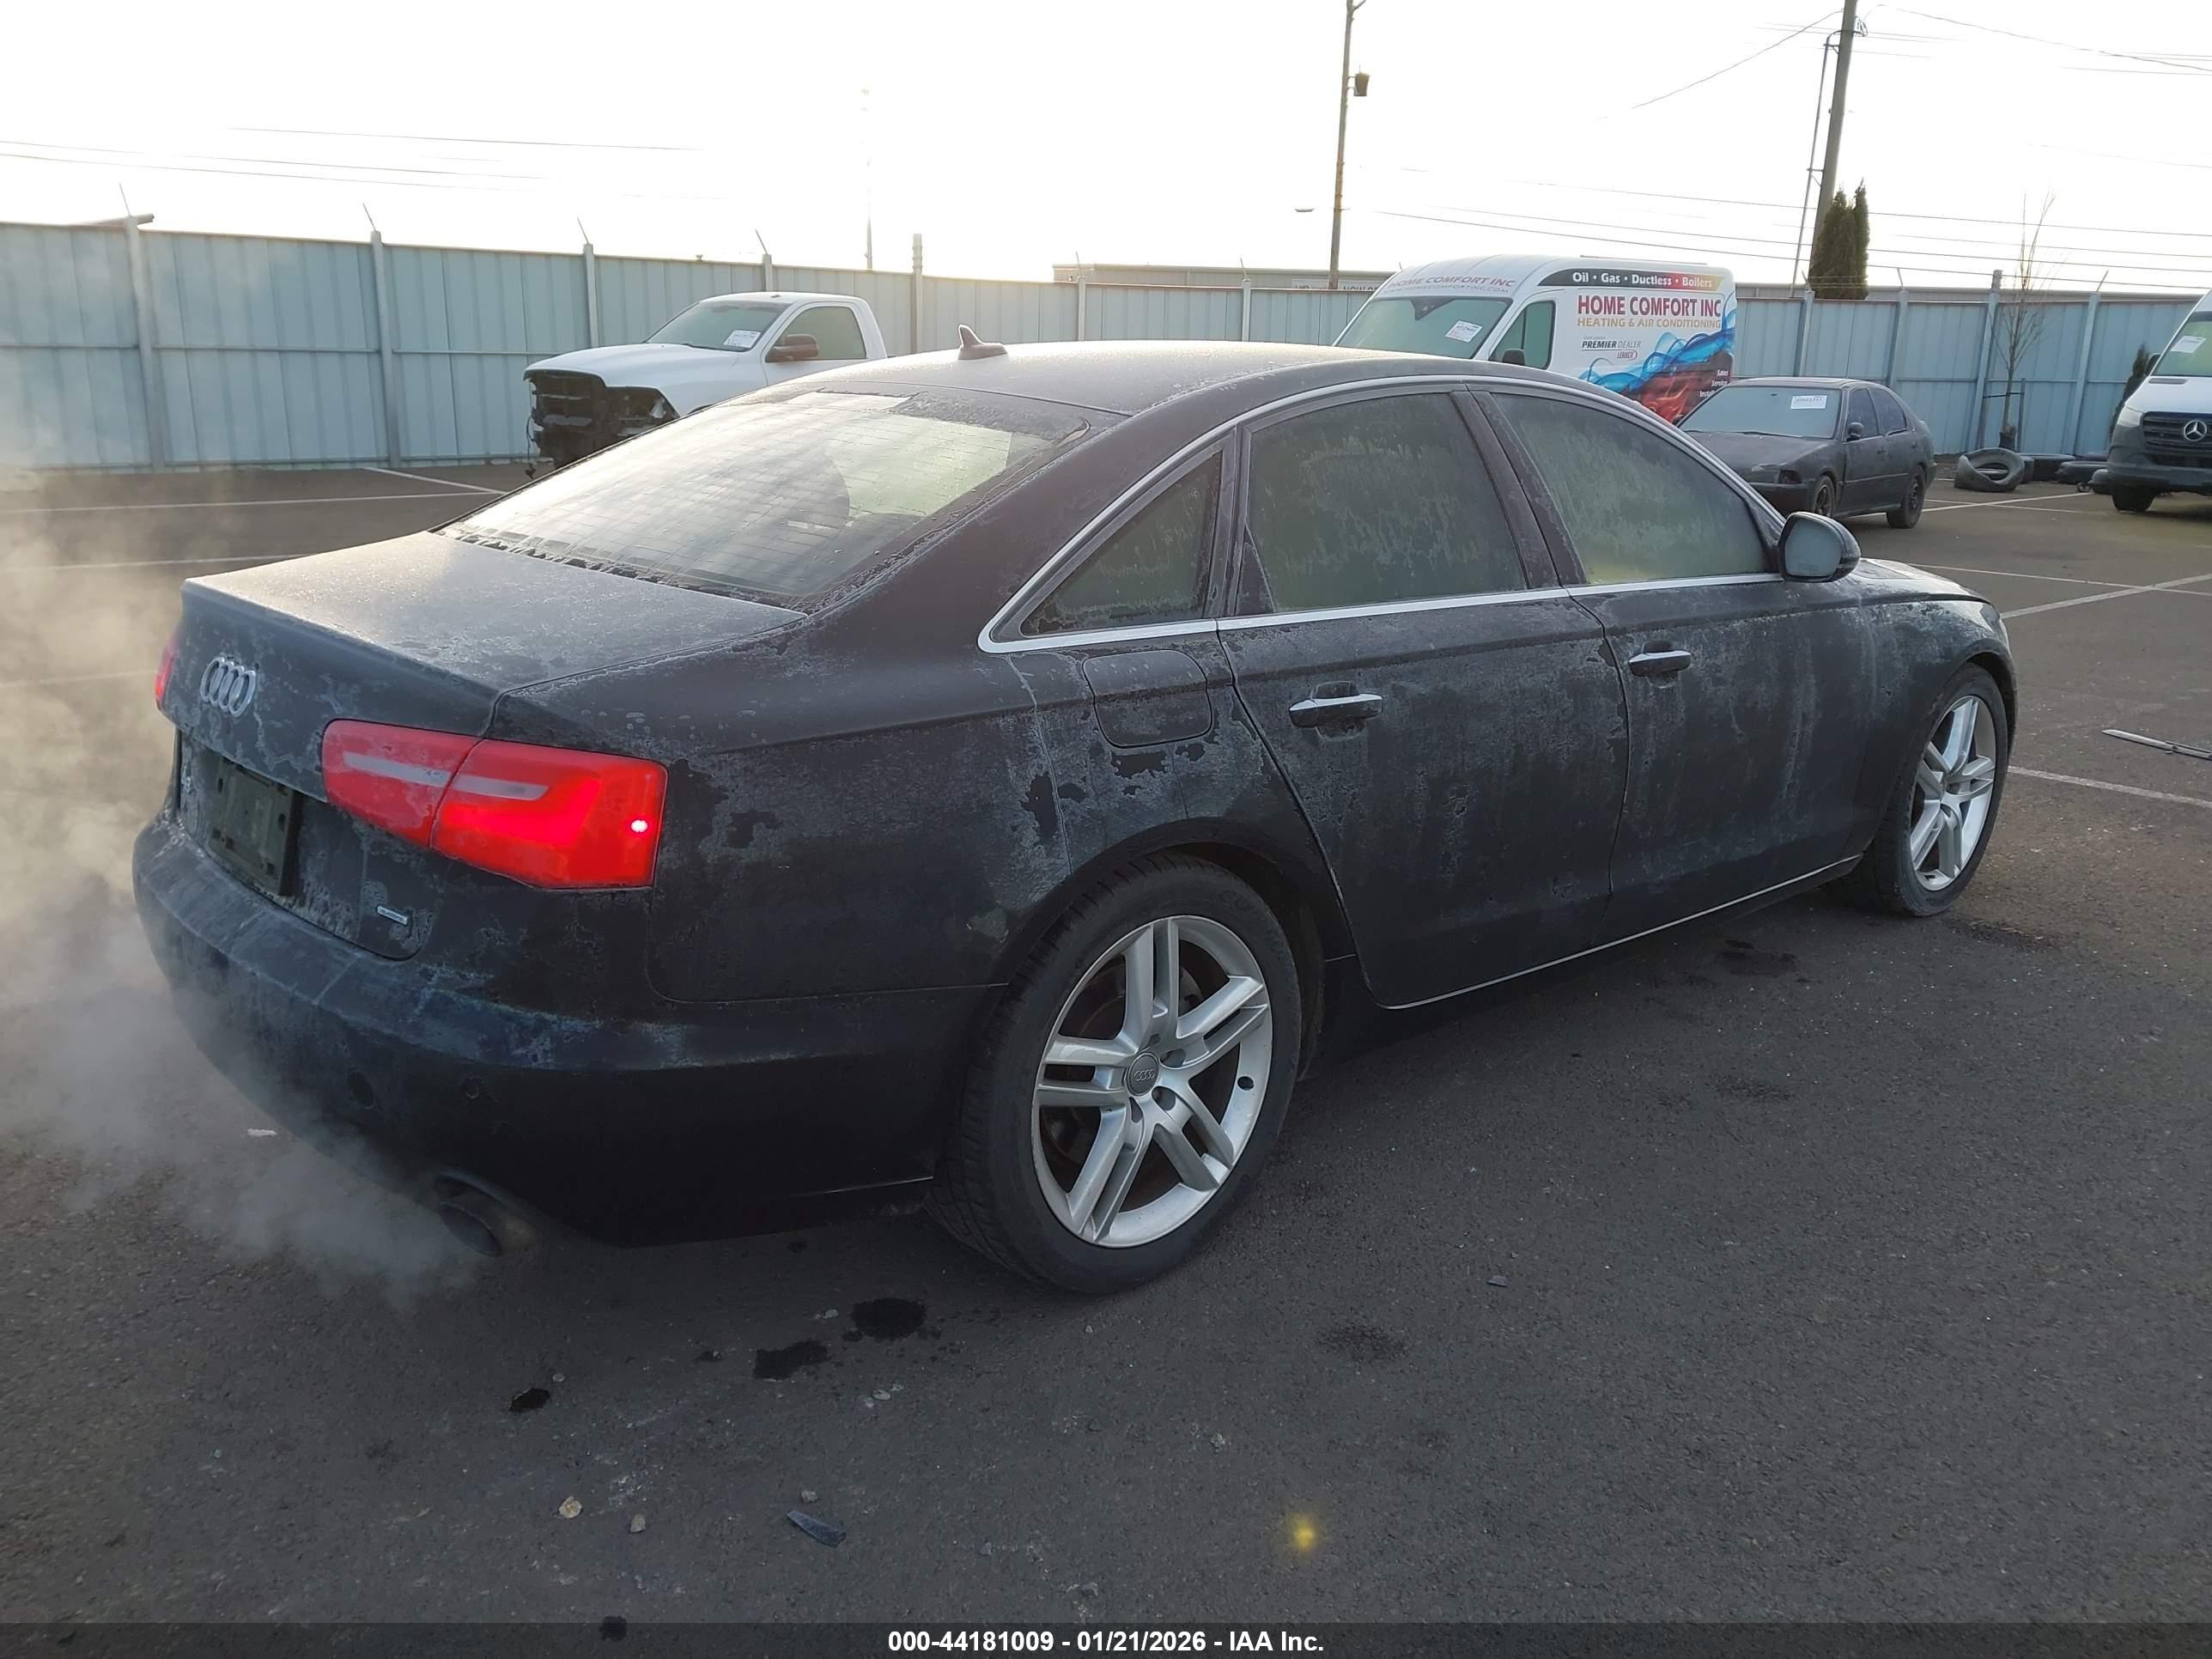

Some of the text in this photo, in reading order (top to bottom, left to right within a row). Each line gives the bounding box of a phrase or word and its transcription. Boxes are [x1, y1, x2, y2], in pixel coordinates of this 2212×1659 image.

[1389, 276, 1516, 288] HOME COMFORT INC
[1572, 272, 1713, 288] Oil Gas Ductless Boilers
[1577, 295, 1722, 318] HOME COMFORT INC
[1577, 318, 1722, 329] HEATING & AIR CONDITIONING
[1582, 340, 1642, 349] PREMIER DEALER
